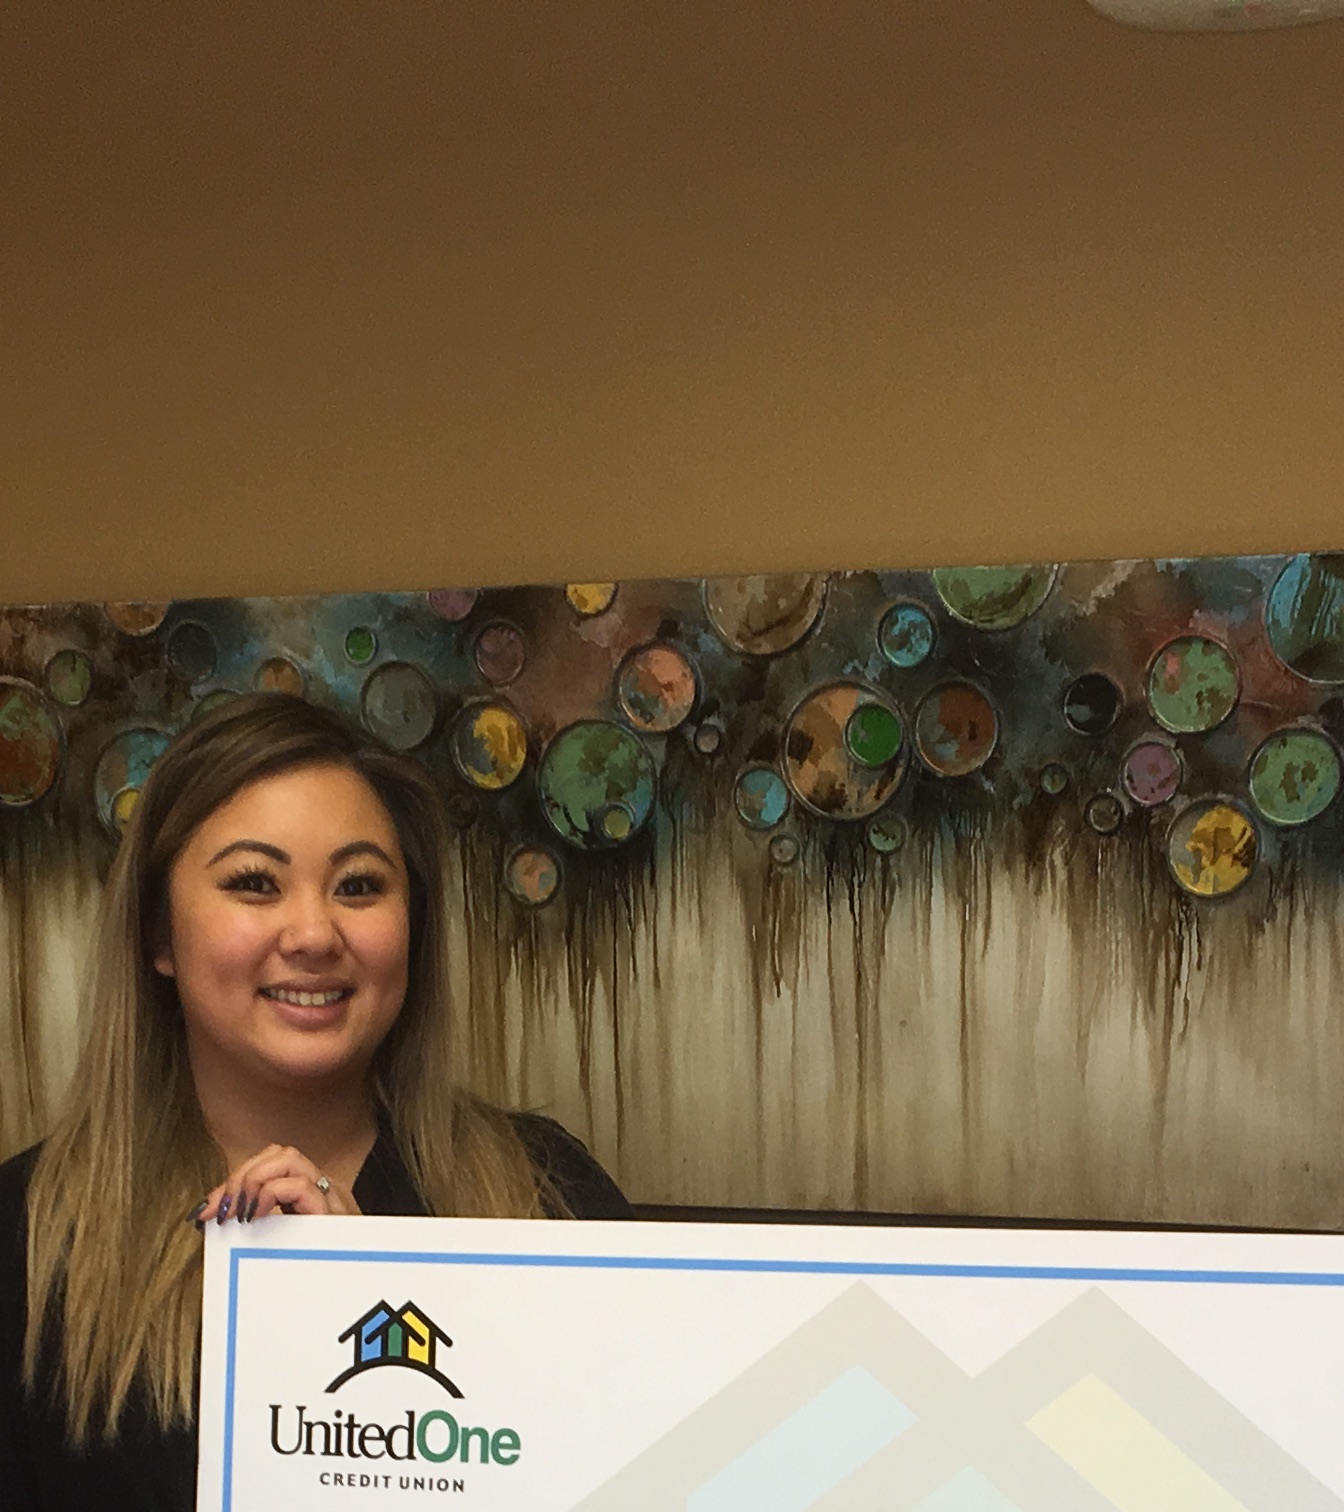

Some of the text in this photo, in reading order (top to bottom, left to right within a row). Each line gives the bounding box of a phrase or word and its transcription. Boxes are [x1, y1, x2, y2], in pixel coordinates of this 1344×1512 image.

[268, 1404, 521, 1466] UnitedOne
[318, 1471, 466, 1493] CREDIT UNION
